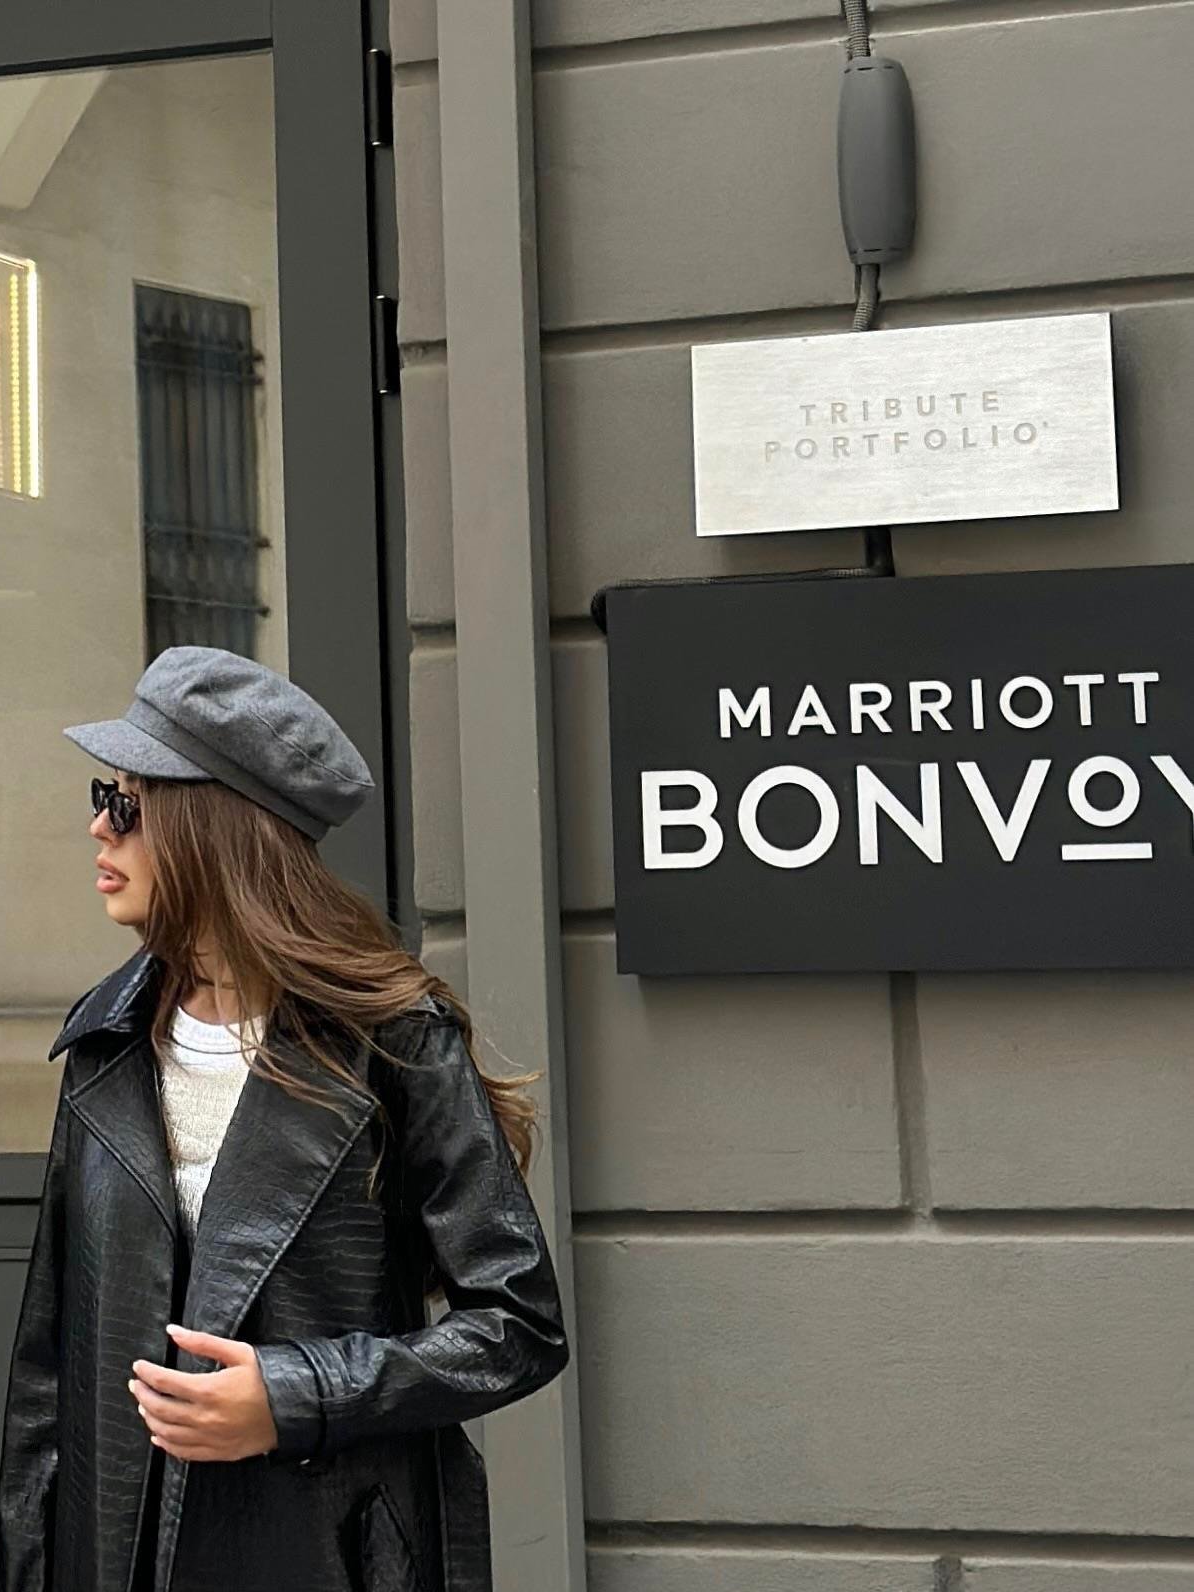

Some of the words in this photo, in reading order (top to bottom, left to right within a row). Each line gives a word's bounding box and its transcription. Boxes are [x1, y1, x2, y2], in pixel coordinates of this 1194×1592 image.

[799, 390, 1000, 427] TRIBUTE
[764, 421, 1038, 463] PORTFOLIO
[718, 671, 1160, 738] MARRIOTT
